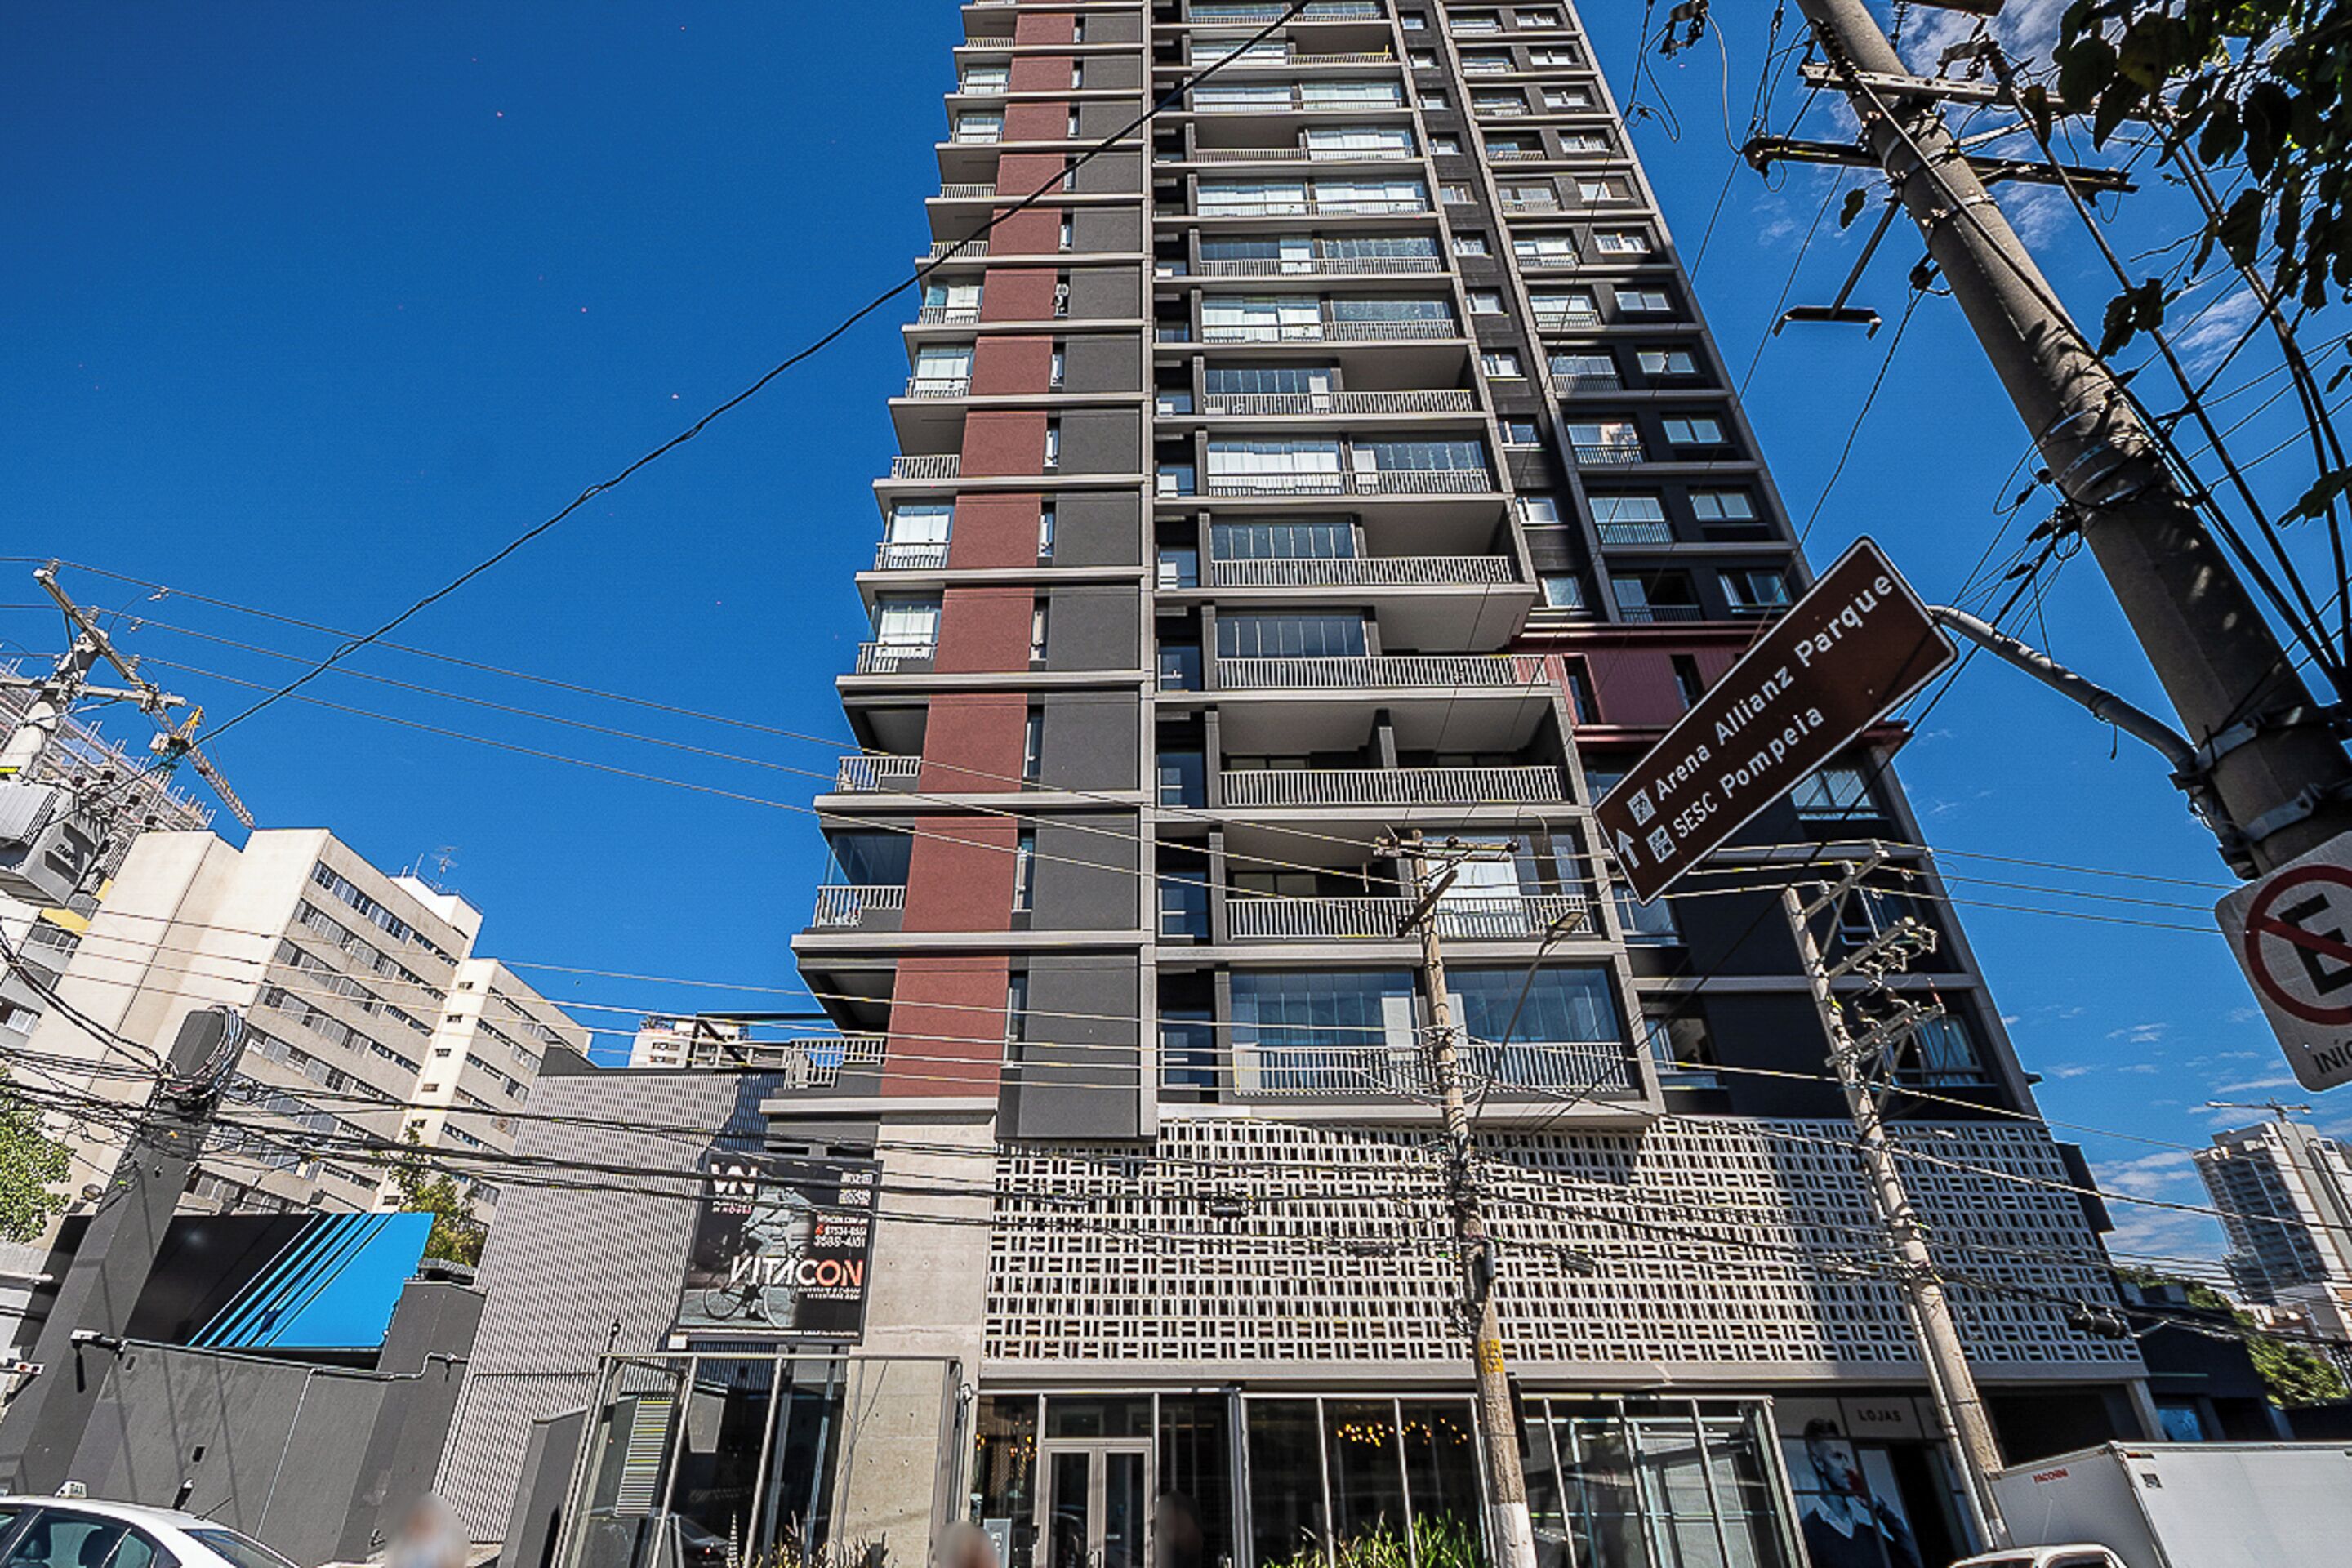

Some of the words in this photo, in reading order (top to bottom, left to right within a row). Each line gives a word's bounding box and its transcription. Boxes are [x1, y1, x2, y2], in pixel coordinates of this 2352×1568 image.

[1655, 744, 1713, 802] Arena
[1714, 666, 1794, 746] Allianz
[1794, 575, 1893, 668] Parque
[1673, 791, 1718, 839] SESC
[1719, 706, 1824, 799] Pompeia
[730, 1254, 864, 1288] VITACON
[1856, 1408, 1902, 1422] LOJAS
